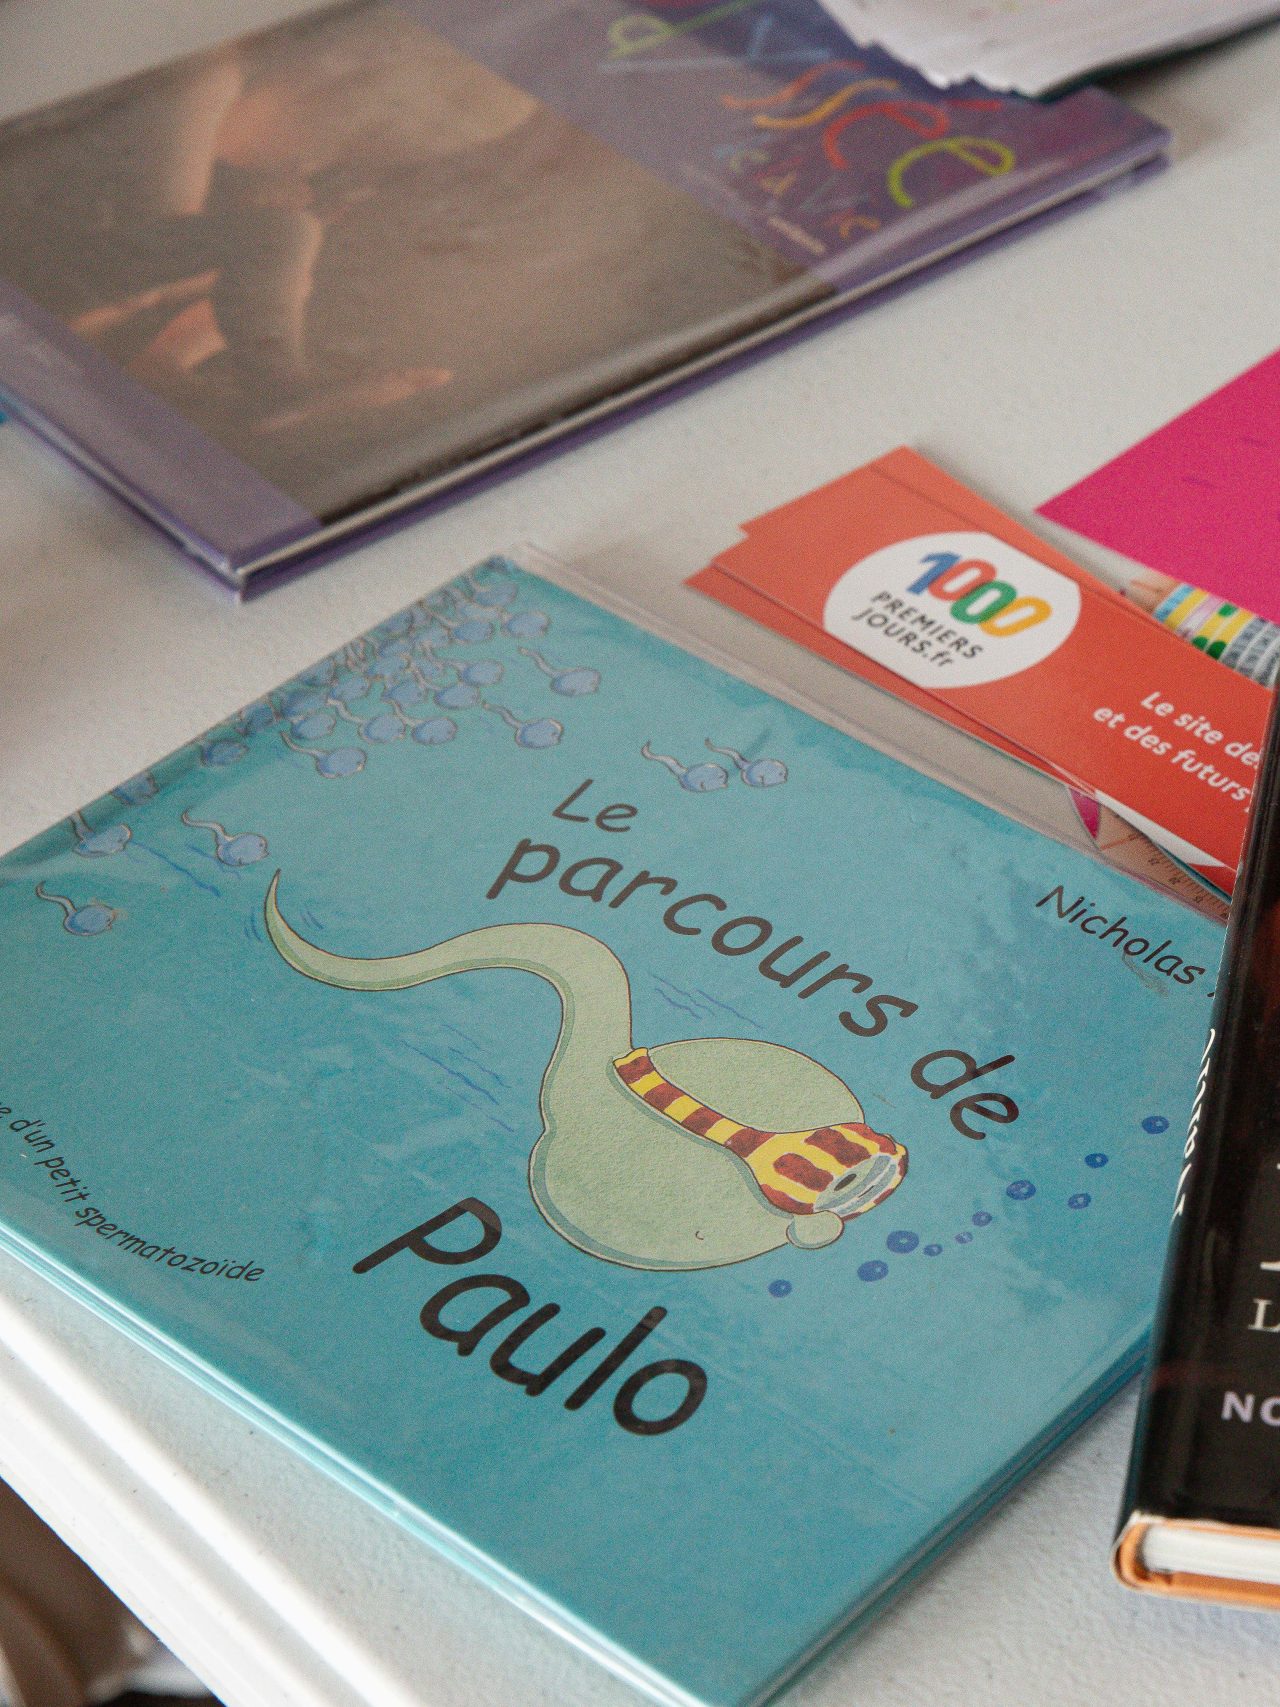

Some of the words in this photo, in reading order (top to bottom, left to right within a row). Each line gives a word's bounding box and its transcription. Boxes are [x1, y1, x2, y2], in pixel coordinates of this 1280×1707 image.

[851, 607, 955, 668] JOURS.fr
[869, 591, 984, 660] PREMIERS
[906, 551, 1052, 637] 1000
[1093, 707, 1126, 730] et
[1123, 725, 1172, 756] des
[1170, 749, 1251, 801] futurs
[1140, 691, 1175, 718] Le
[1173, 713, 1224, 745] site
[1224, 741, 1261, 770] de
[552, 779, 638, 832] Le
[1036, 884, 1206, 985] Nicholas
[486, 838, 918, 1037] parcours
[910, 1048, 1020, 1140] de
[9, 1118, 55, 1154] d'un
[33, 1156, 90, 1203] petit
[75, 1206, 265, 1282] spermatozoïde
[352, 1197, 707, 1436] Paulo
